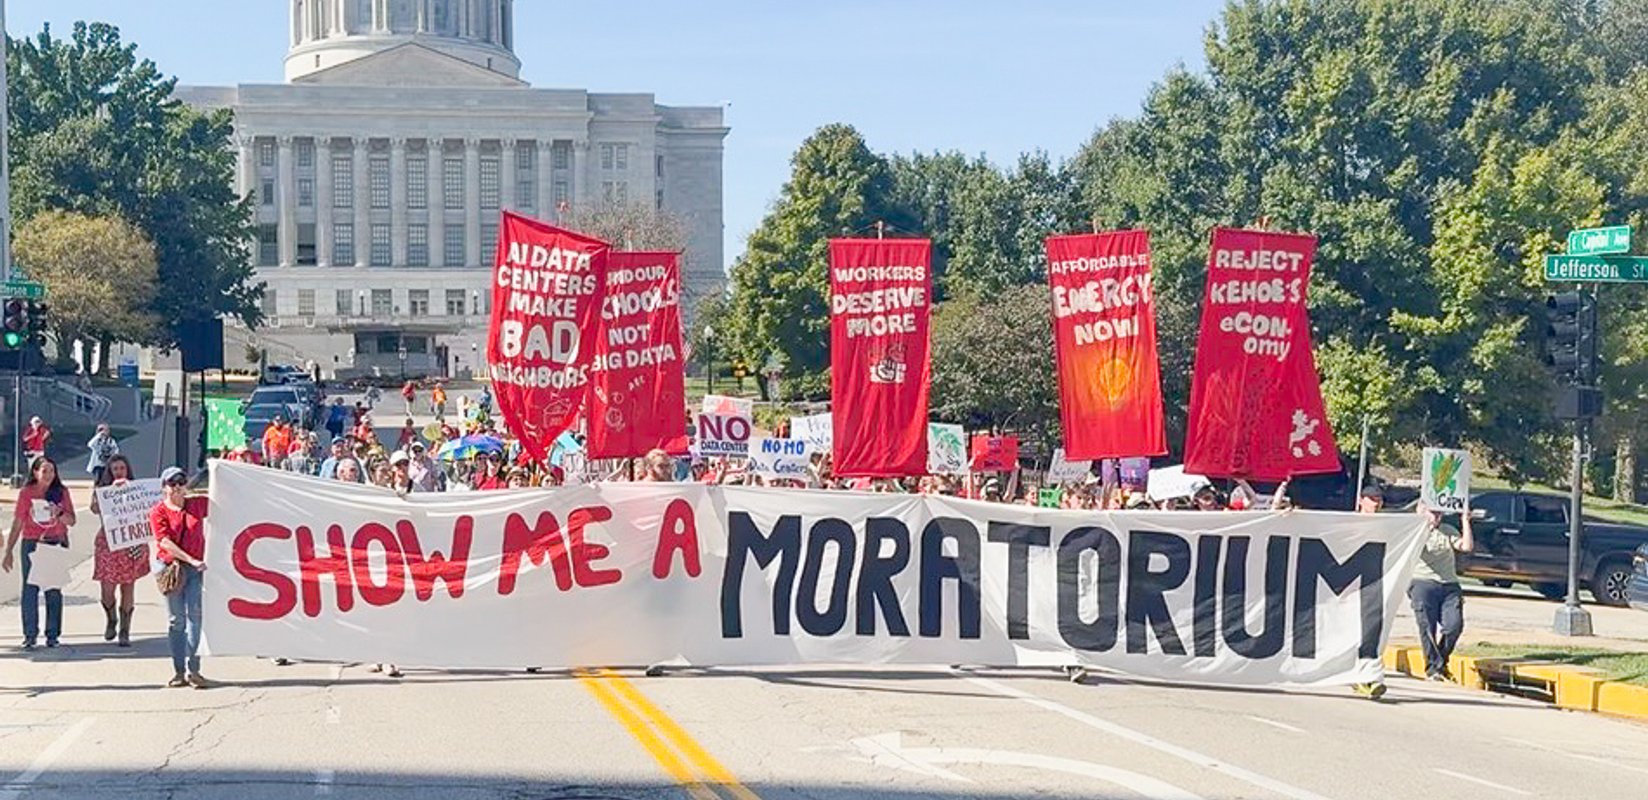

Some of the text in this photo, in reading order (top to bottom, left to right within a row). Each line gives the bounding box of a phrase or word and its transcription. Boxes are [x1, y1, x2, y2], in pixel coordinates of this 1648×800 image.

[507, 242, 592, 272] AI DATA
[1051, 254, 1147, 275] AFFORDABLE
[1215, 249, 1303, 271] REJECT
[1549, 259, 1644, 277] Jefferson St
[498, 265, 597, 295] CENTERS
[635, 264, 664, 281] OUR
[834, 266, 925, 282] WORKERS
[509, 291, 577, 317] MAKE
[601, 278, 680, 320] CHOOLS
[832, 287, 925, 315] DESERVE
[1053, 273, 1151, 318] ENERGY
[1211, 278, 1302, 304] KEHOE'S
[608, 324, 651, 346] NOT
[846, 314, 916, 338] MORE
[502, 320, 580, 364] BAD
[1243, 336, 1291, 362] omy
[591, 343, 676, 371] BIG DATA
[699, 415, 751, 442] NO
[700, 441, 749, 453] DATA CENTER
[762, 439, 805, 455] NO MO
[228, 498, 1386, 659] SHOW ME A MORATORIUM
